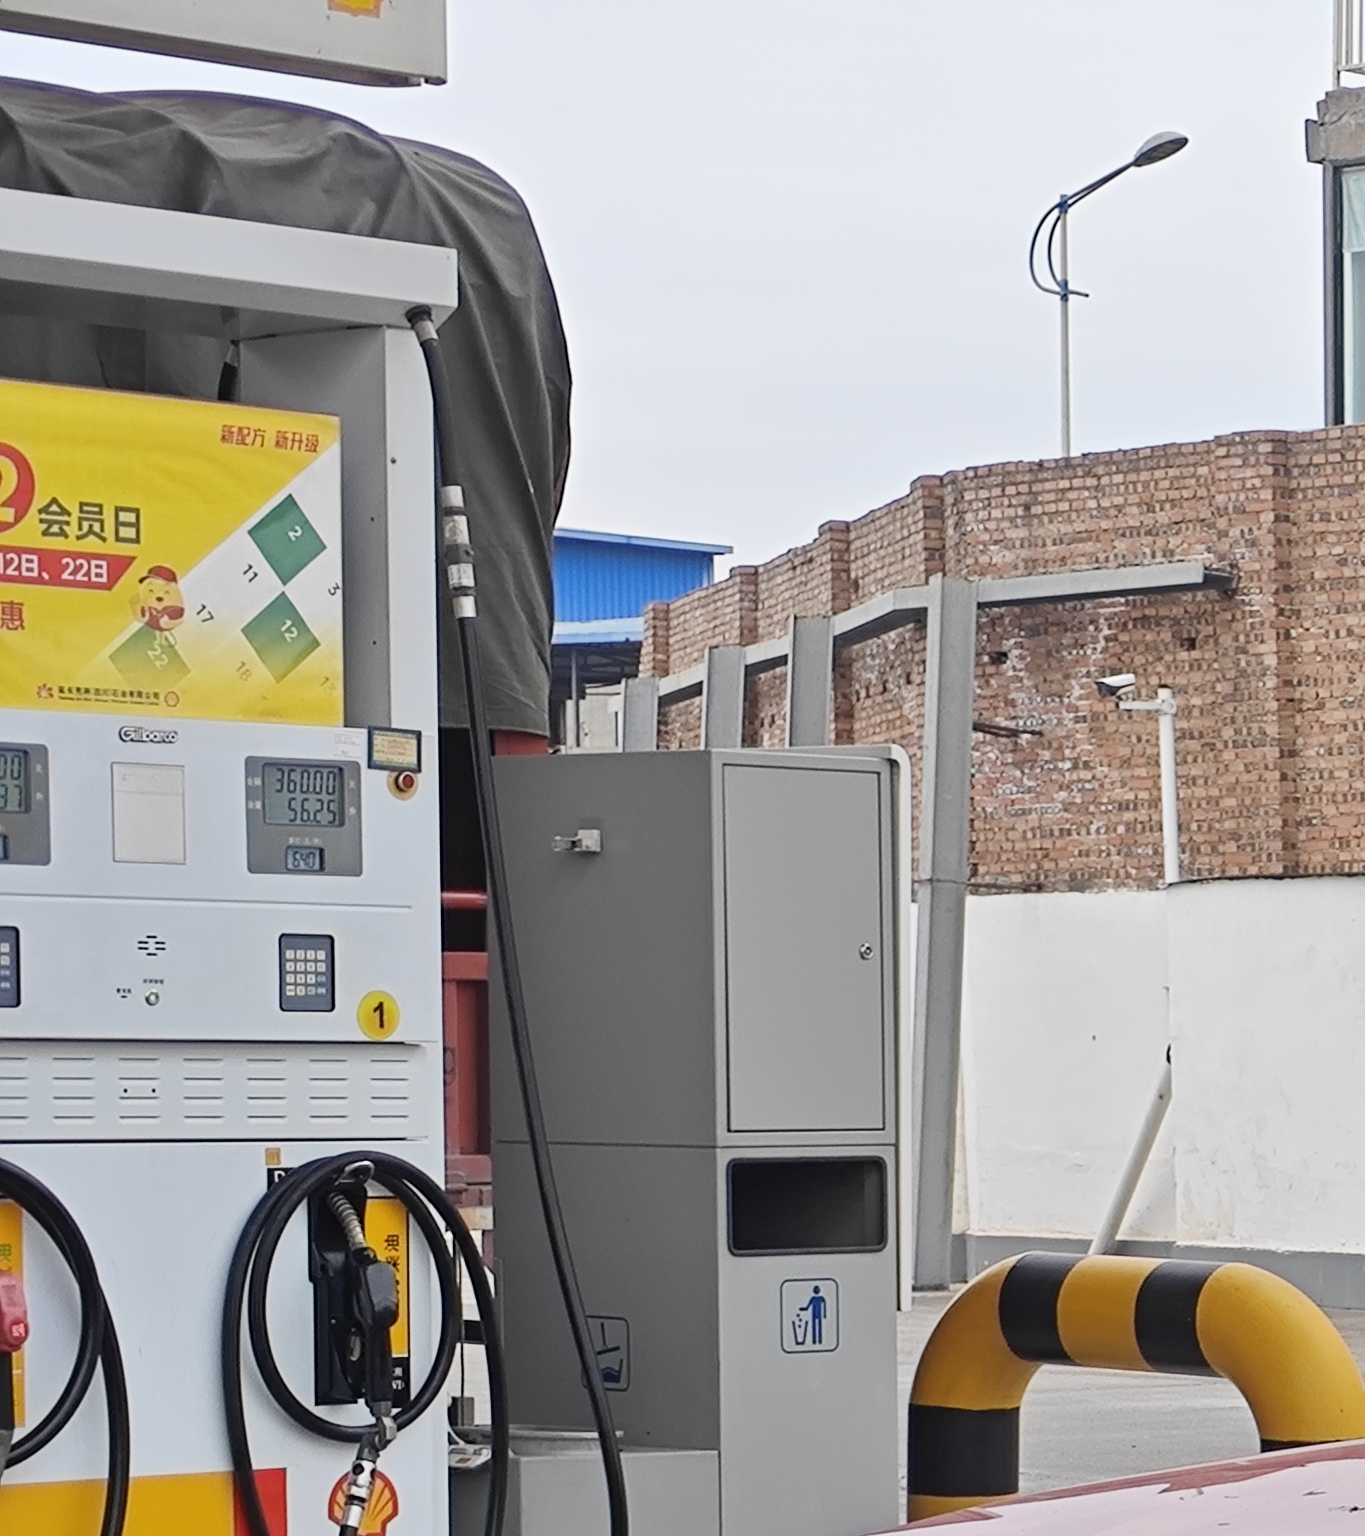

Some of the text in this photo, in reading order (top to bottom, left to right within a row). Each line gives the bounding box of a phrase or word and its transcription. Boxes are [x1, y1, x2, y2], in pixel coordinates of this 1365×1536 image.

[219, 424, 320, 453] 新配方 新升级
[37, 496, 141, 545] 会员日
[287, 525, 303, 542] 2
[242, 563, 259, 584] 11
[327, 582, 341, 597] 3
[0, 600, 26, 632] 惠
[195, 603, 215, 624] 17
[280, 618, 299, 644] 12
[146, 643, 170, 670] 22
[274, 767, 337, 797] 360.00
[287, 797, 337, 825] 56.25
[372, 1000, 385, 1029] 1
